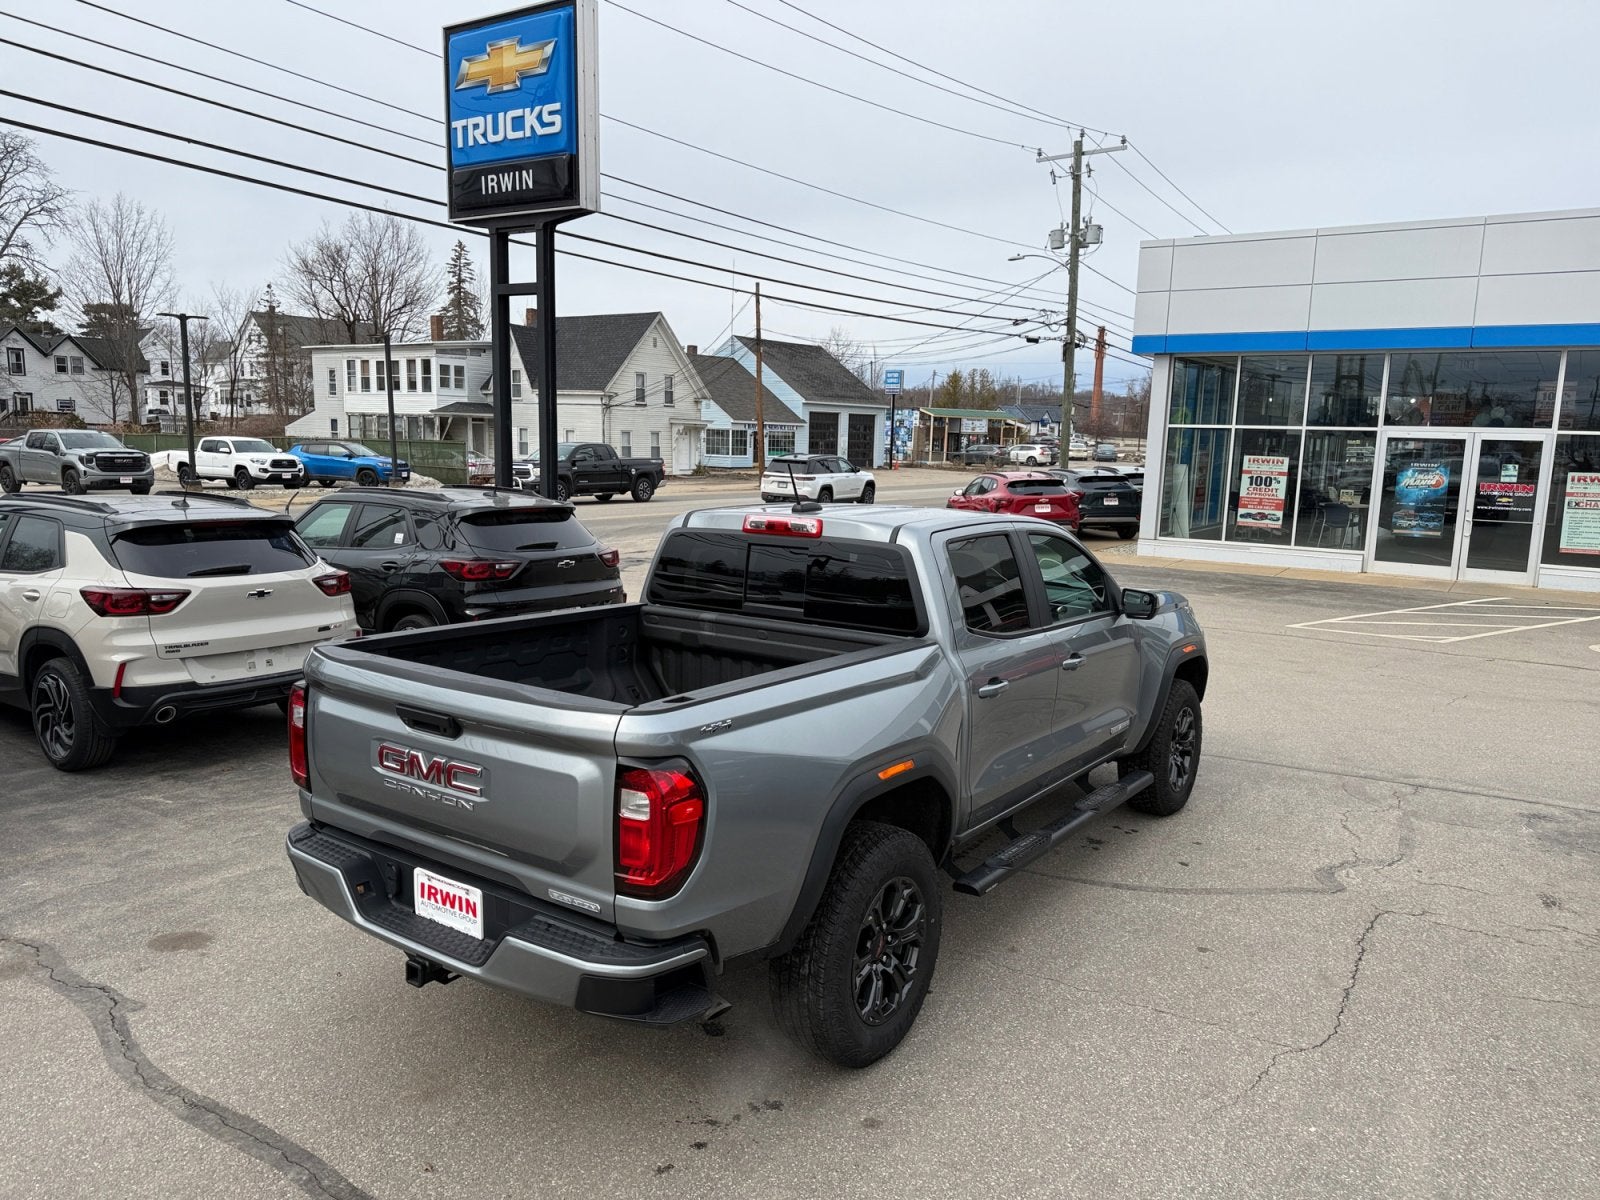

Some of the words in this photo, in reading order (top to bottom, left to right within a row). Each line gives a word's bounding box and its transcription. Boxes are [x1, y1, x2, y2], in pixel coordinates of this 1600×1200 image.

[452, 102, 562, 148] TRUCKS
[481, 169, 533, 195] IRWIN
[1248, 457, 1284, 465] IRWIN
[1248, 476, 1280, 487] 100%
[1480, 482, 1534, 493] IRWIN
[378, 742, 483, 796] GMC
[384, 778, 474, 811] CANYON
[420, 882, 477, 918] IRWIN
[421, 900, 458, 918] AUTOMOTIVE
[458, 913, 477, 925] GROUP
